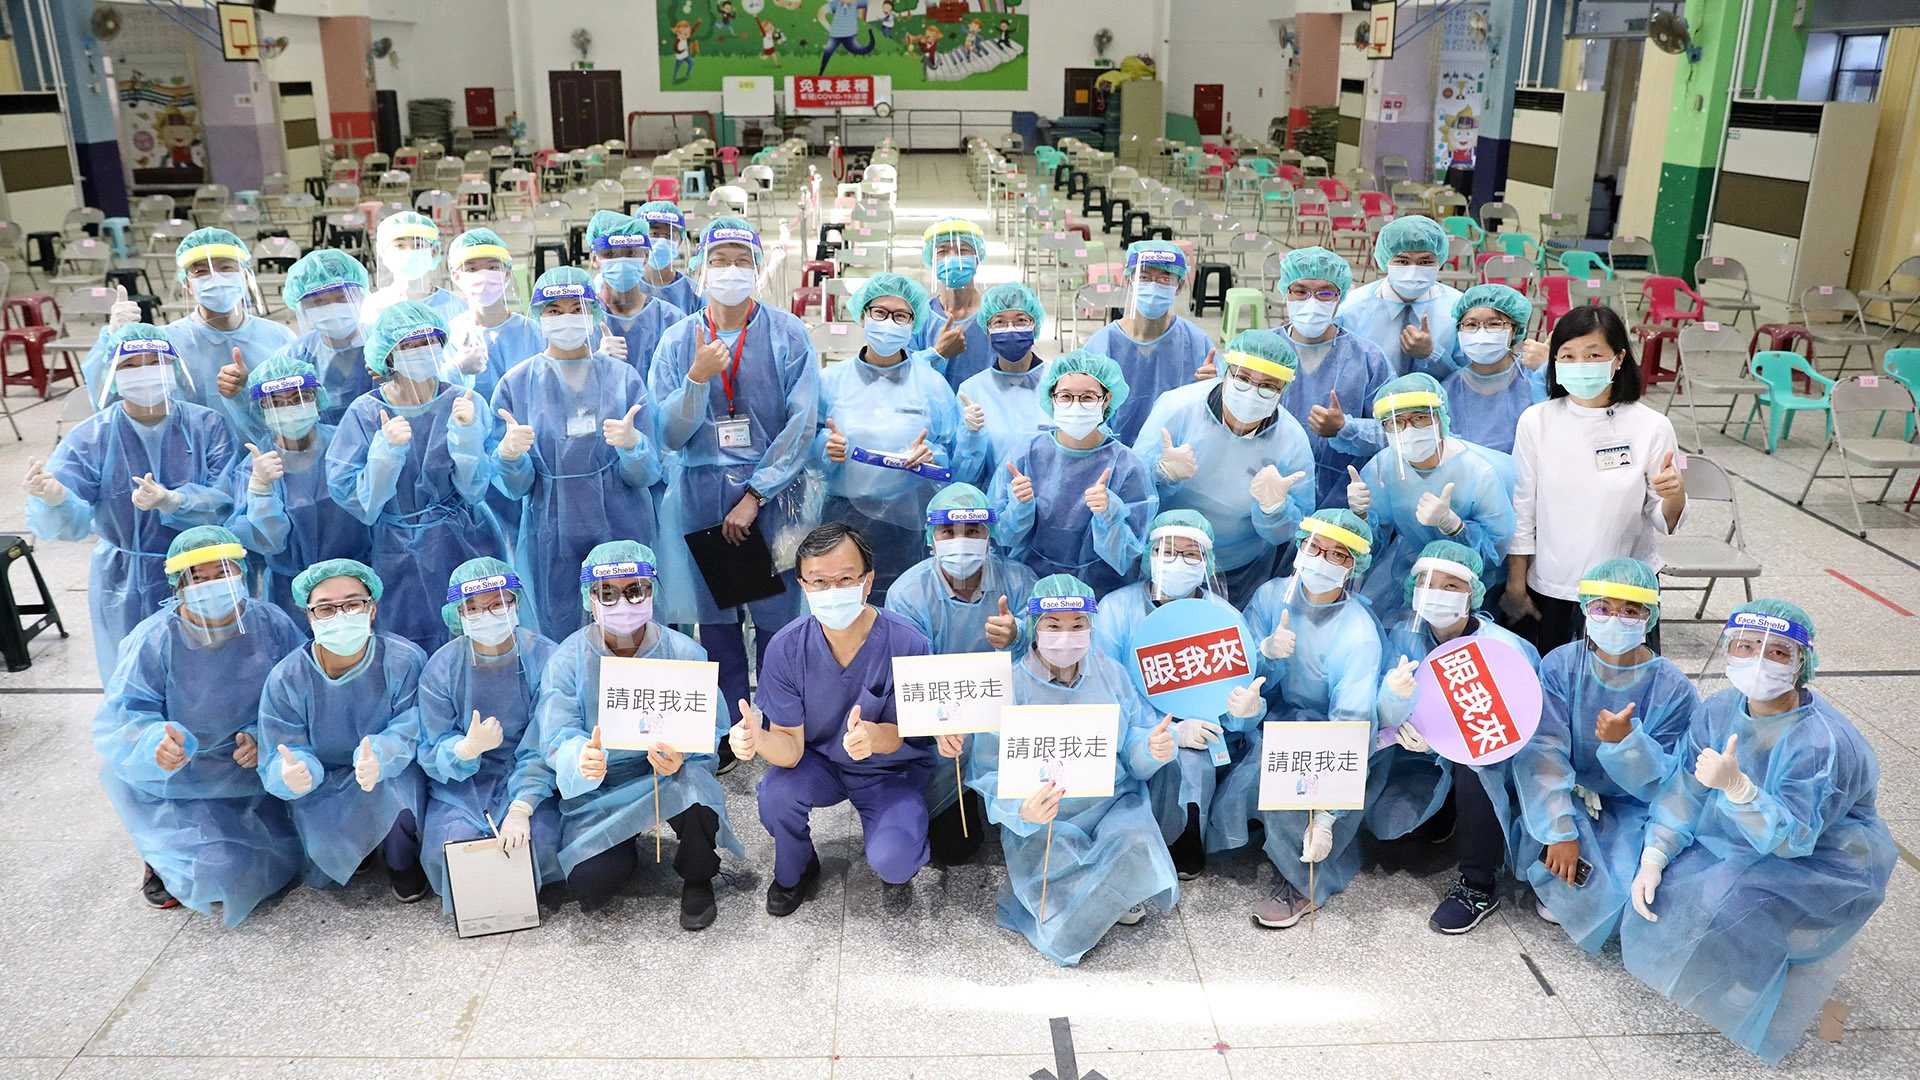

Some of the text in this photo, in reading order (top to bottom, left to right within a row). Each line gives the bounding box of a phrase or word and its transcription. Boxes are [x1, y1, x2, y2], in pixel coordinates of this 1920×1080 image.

[799, 78, 869, 93] 免費接種
[1155, 254, 1174, 262] Shield
[545, 288, 561, 297] Face
[264, 379, 302, 392] Face Shield
[885, 459, 901, 467] Face
[967, 512, 987, 520] Shield
[595, 566, 636, 576] Face Shield
[464, 579, 505, 593] Face Shied
[1059, 600, 1083, 608] Shield
[1737, 616, 1757, 625] Face
[1141, 638, 1247, 689] 跟我來
[902, 677, 1003, 702] 請跟我走
[607, 686, 708, 713] 請跟我走
[1437, 648, 1509, 755] 跟我來
[1007, 735, 1108, 759] 請跟我走
[1267, 750, 1359, 773] 請跟我走
